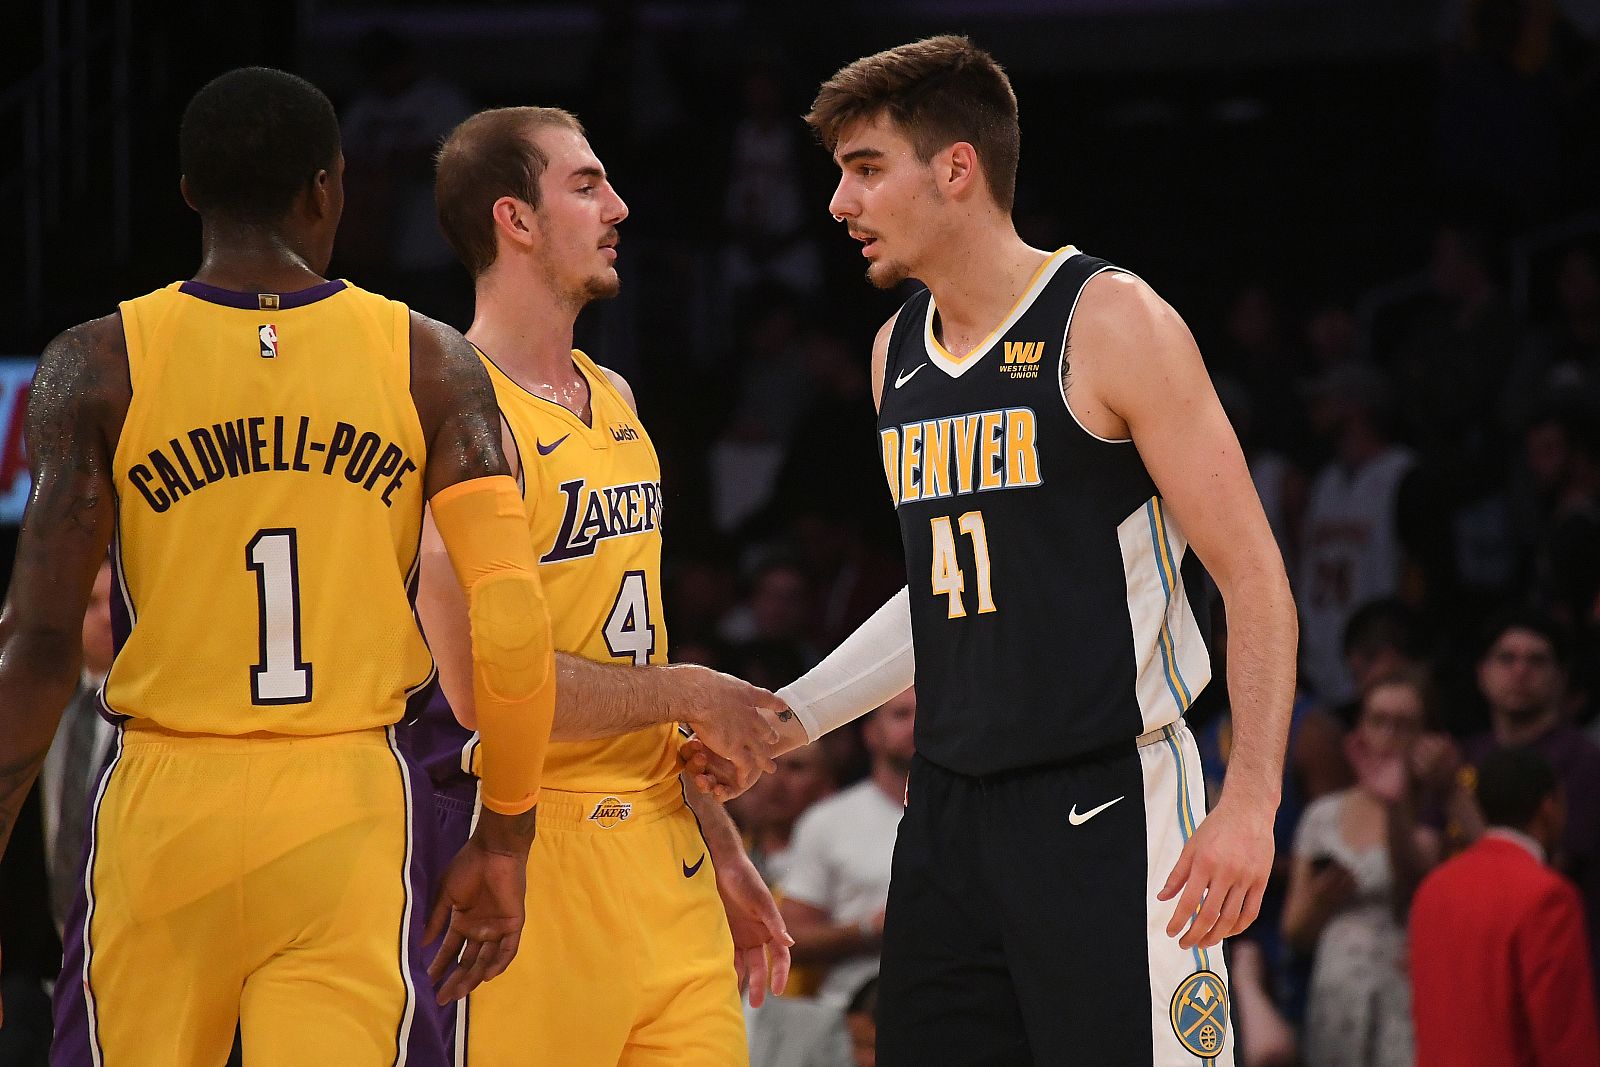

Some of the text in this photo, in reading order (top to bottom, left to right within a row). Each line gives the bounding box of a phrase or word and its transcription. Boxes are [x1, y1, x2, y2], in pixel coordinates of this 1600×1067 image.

[999, 364, 1040, 373] WESTERN
[1004, 341, 1046, 364] WU
[1010, 371, 1039, 379] UNION
[608, 423, 640, 441] wish
[879, 406, 1044, 511] DENVER
[128, 416, 417, 513] CALDWELL-POPE
[930, 510, 997, 619] 41
[245, 527, 313, 706] 1
[601, 569, 655, 667] 4
[588, 804, 631, 820] LAKERS
